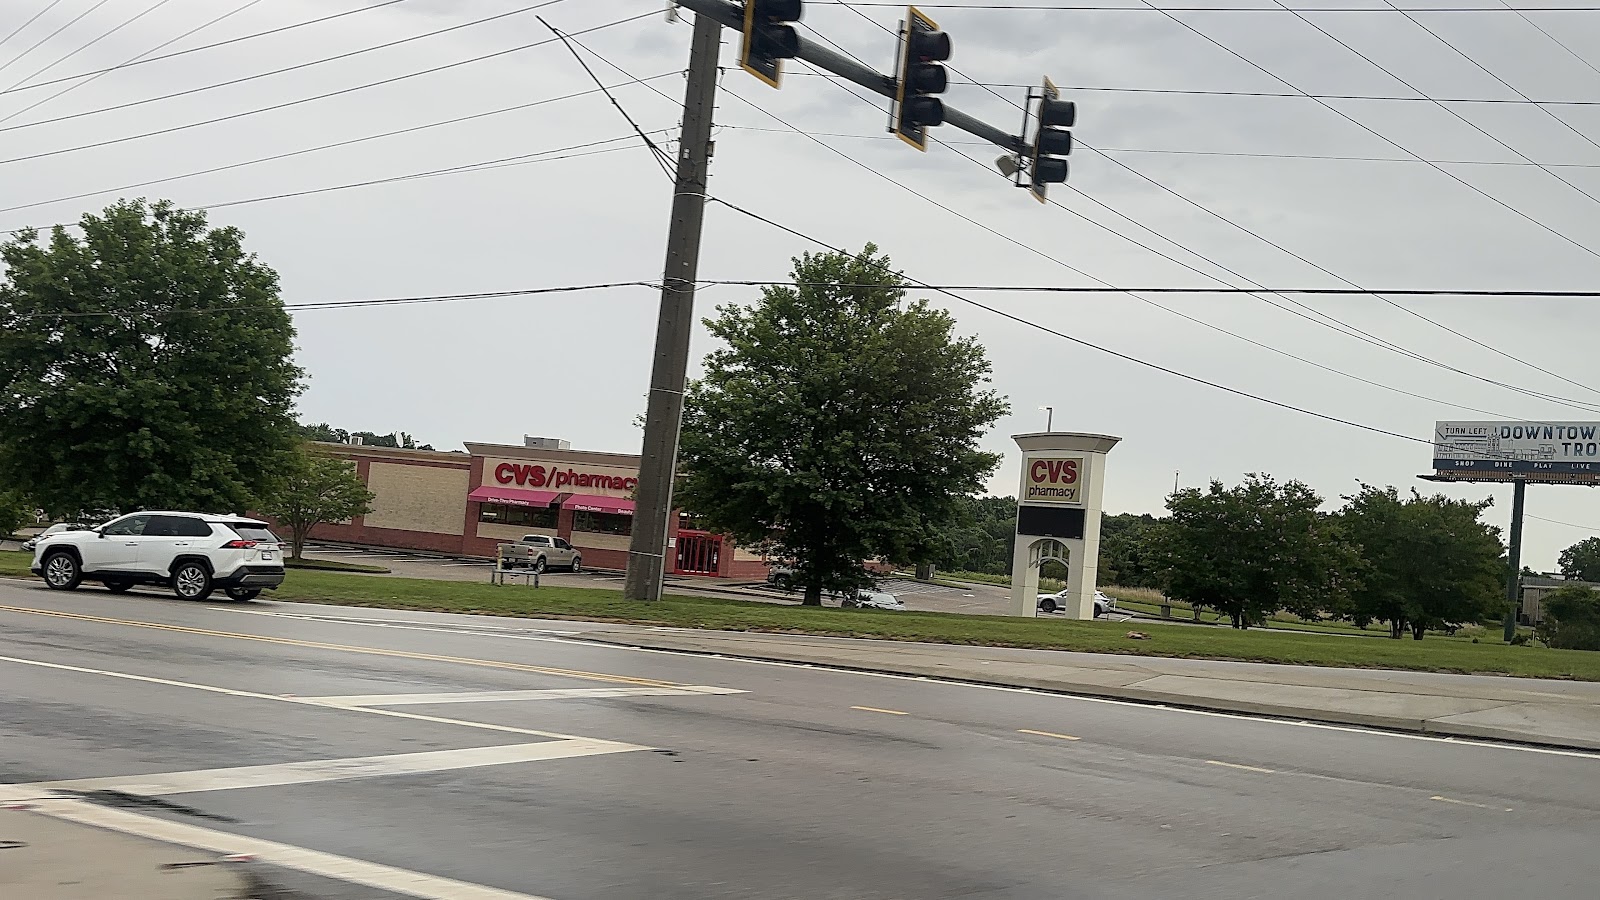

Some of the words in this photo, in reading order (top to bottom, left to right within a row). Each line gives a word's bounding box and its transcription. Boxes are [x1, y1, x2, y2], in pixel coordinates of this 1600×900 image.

[1445, 427, 1466, 435] TURN
[1468, 427, 1487, 435] LEFT
[1501, 425, 1600, 440] DOWNTOW
[1561, 442, 1600, 457] TRO
[495, 462, 639, 489] CVS/pharmac
[1031, 460, 1077, 484] CVS
[1028, 485, 1076, 499] pharmacy
